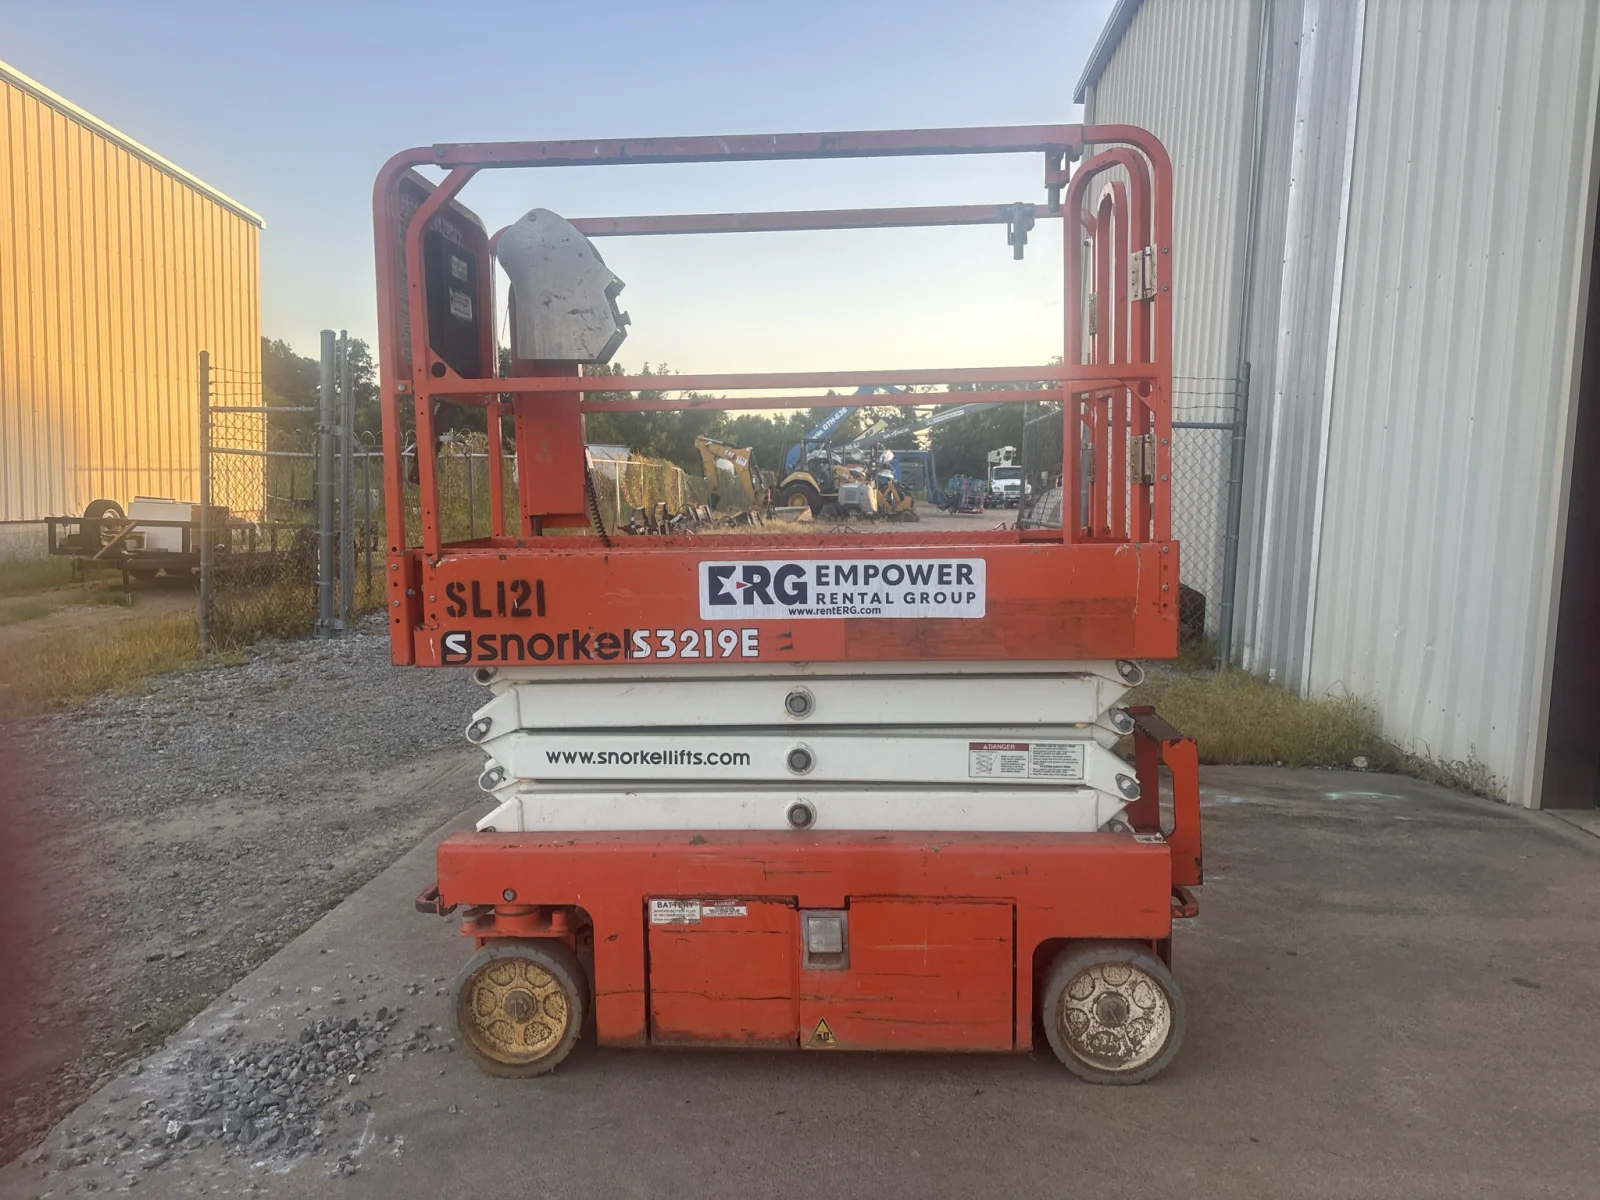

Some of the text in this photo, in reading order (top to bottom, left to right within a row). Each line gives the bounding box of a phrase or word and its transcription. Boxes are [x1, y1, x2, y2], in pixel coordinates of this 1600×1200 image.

[822, 406, 848, 431] GTH-636
[708, 563, 975, 606] ERG EMPOWER
[816, 591, 976, 605] RENTAL GROUP
[788, 606, 882, 616] www.rentERG.com
[477, 629, 632, 661] snorkel
[632, 628, 759, 659] S3219E
[546, 749, 751, 765] www.snorkellifts.com
